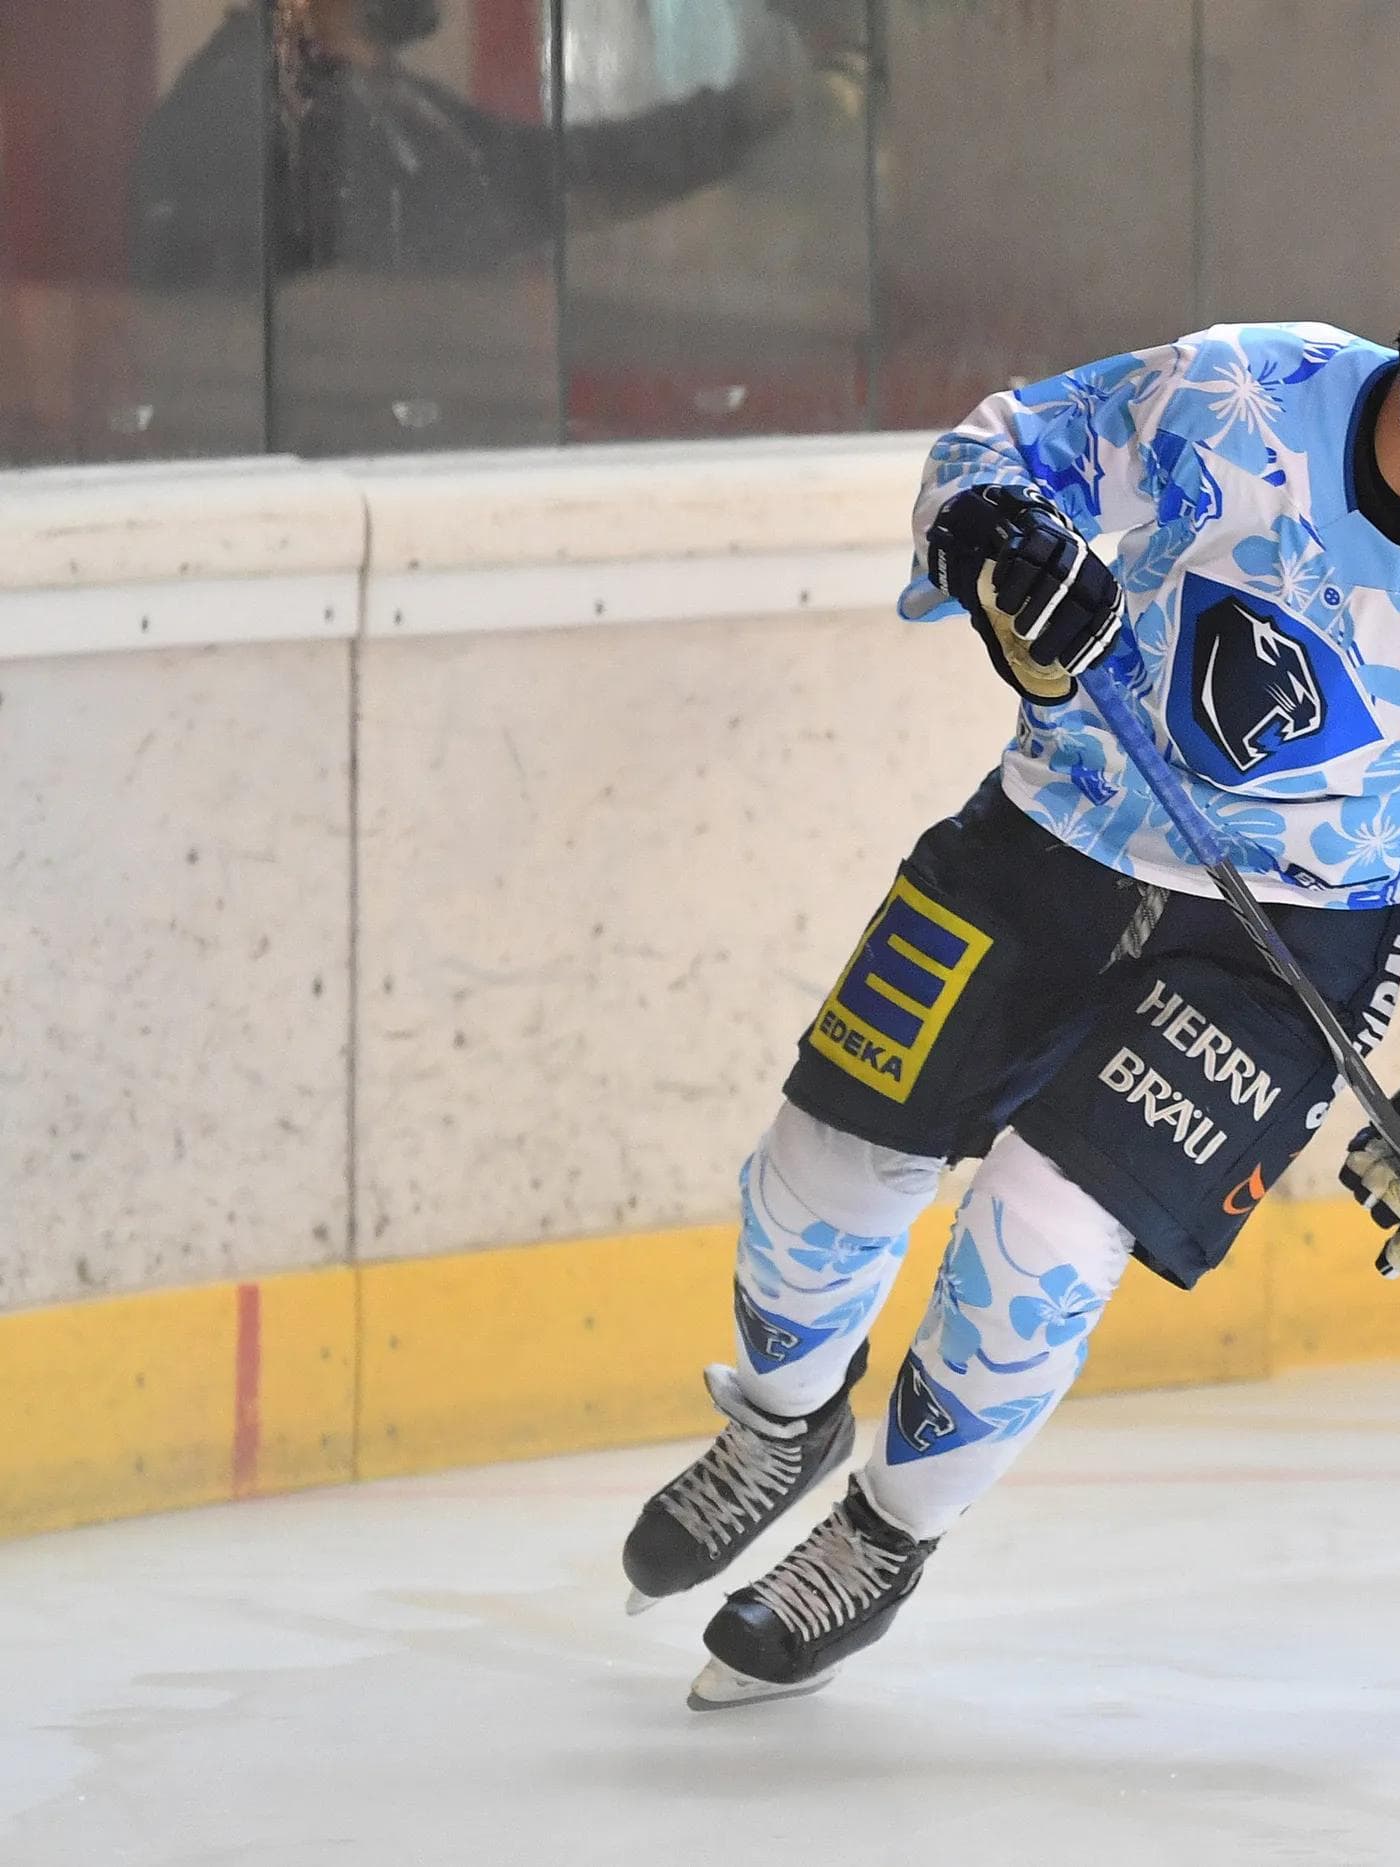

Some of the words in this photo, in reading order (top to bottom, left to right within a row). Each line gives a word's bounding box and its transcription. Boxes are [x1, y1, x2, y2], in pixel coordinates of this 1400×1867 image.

[819, 1010, 903, 1082] EDEKA
[1098, 1046, 1228, 1165] BRÄU
[1136, 979, 1281, 1121] HERRN
